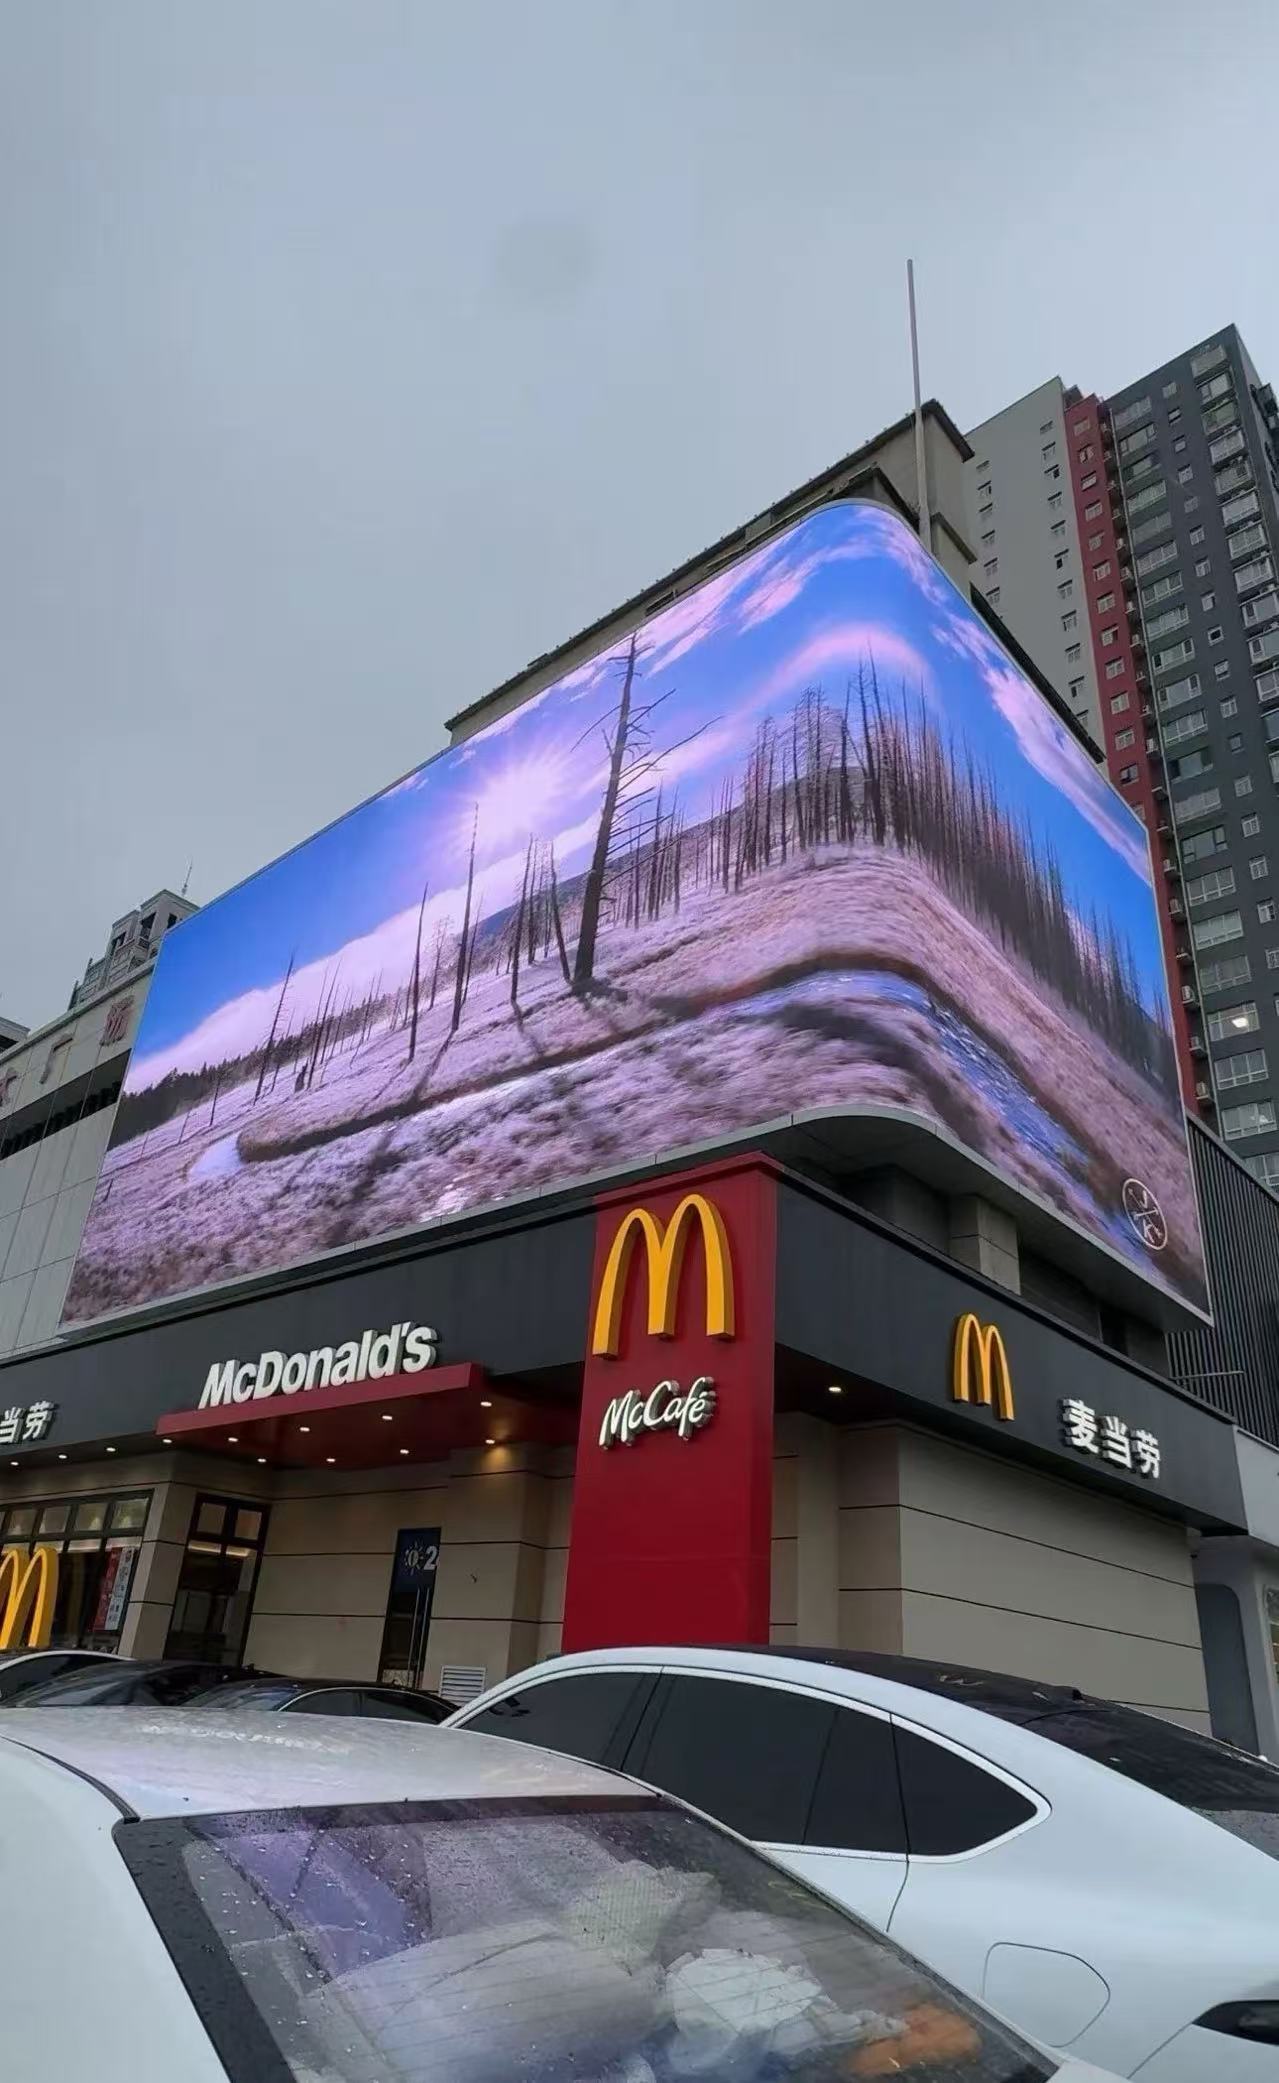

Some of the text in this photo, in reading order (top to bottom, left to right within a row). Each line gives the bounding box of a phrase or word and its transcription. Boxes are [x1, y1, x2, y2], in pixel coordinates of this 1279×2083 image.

[197, 1321, 437, 1410] McDonald's
[0, 1400, 54, 1444] 当劳
[598, 1376, 715, 1450] McCafé
[1062, 1398, 1162, 1479] 麦当劳
